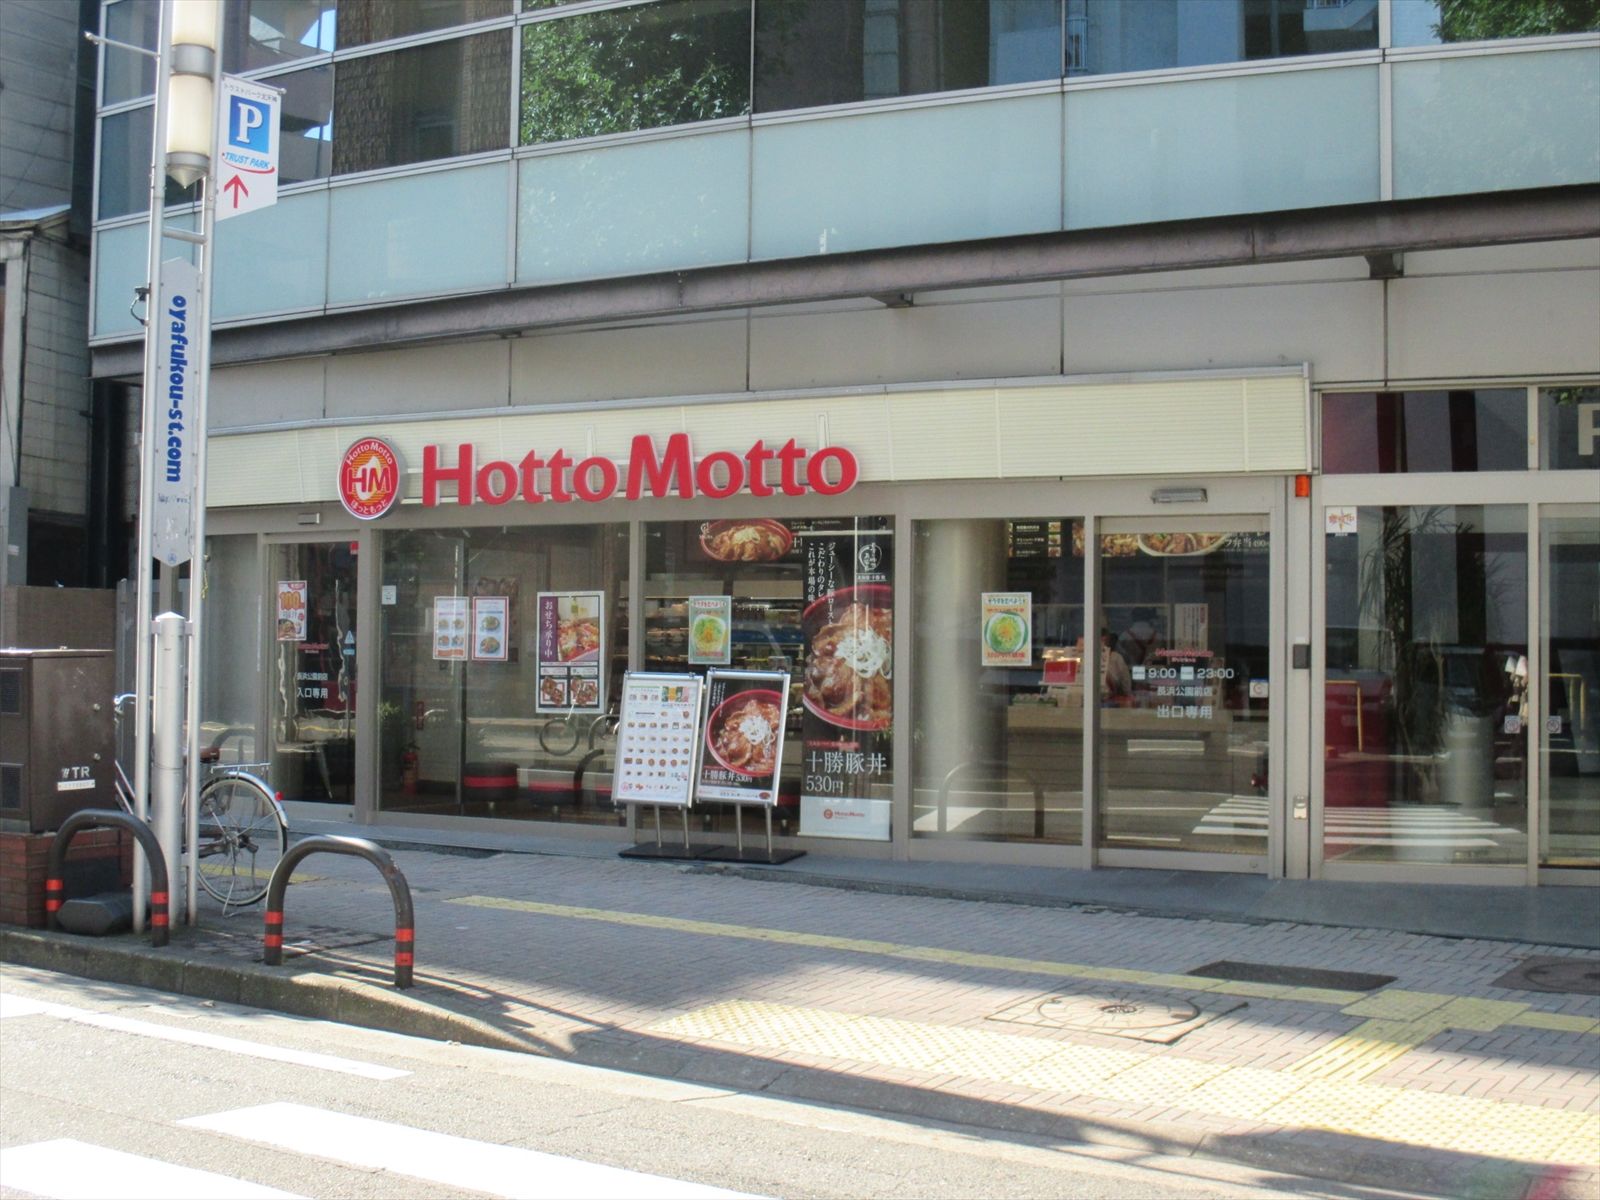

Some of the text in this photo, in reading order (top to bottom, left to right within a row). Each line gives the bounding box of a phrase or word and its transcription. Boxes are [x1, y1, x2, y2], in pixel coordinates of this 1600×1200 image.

[236, 102, 263, 144] P
[225, 151, 270, 169] TRUST PARK
[166, 294, 189, 483] oyafukou-st.com
[346, 466, 392, 494] HM
[422, 432, 859, 507] HottoMotto
[544, 601, 553, 658] おせち承り中
[1148, 667, 1177, 679] 9:00
[1197, 667, 1234, 679] 23:00
[297, 687, 328, 699] 入口専用
[1157, 704, 1212, 719] 出口専用
[806, 751, 887, 775] 十勝豚丼
[806, 775, 844, 794] 530円
